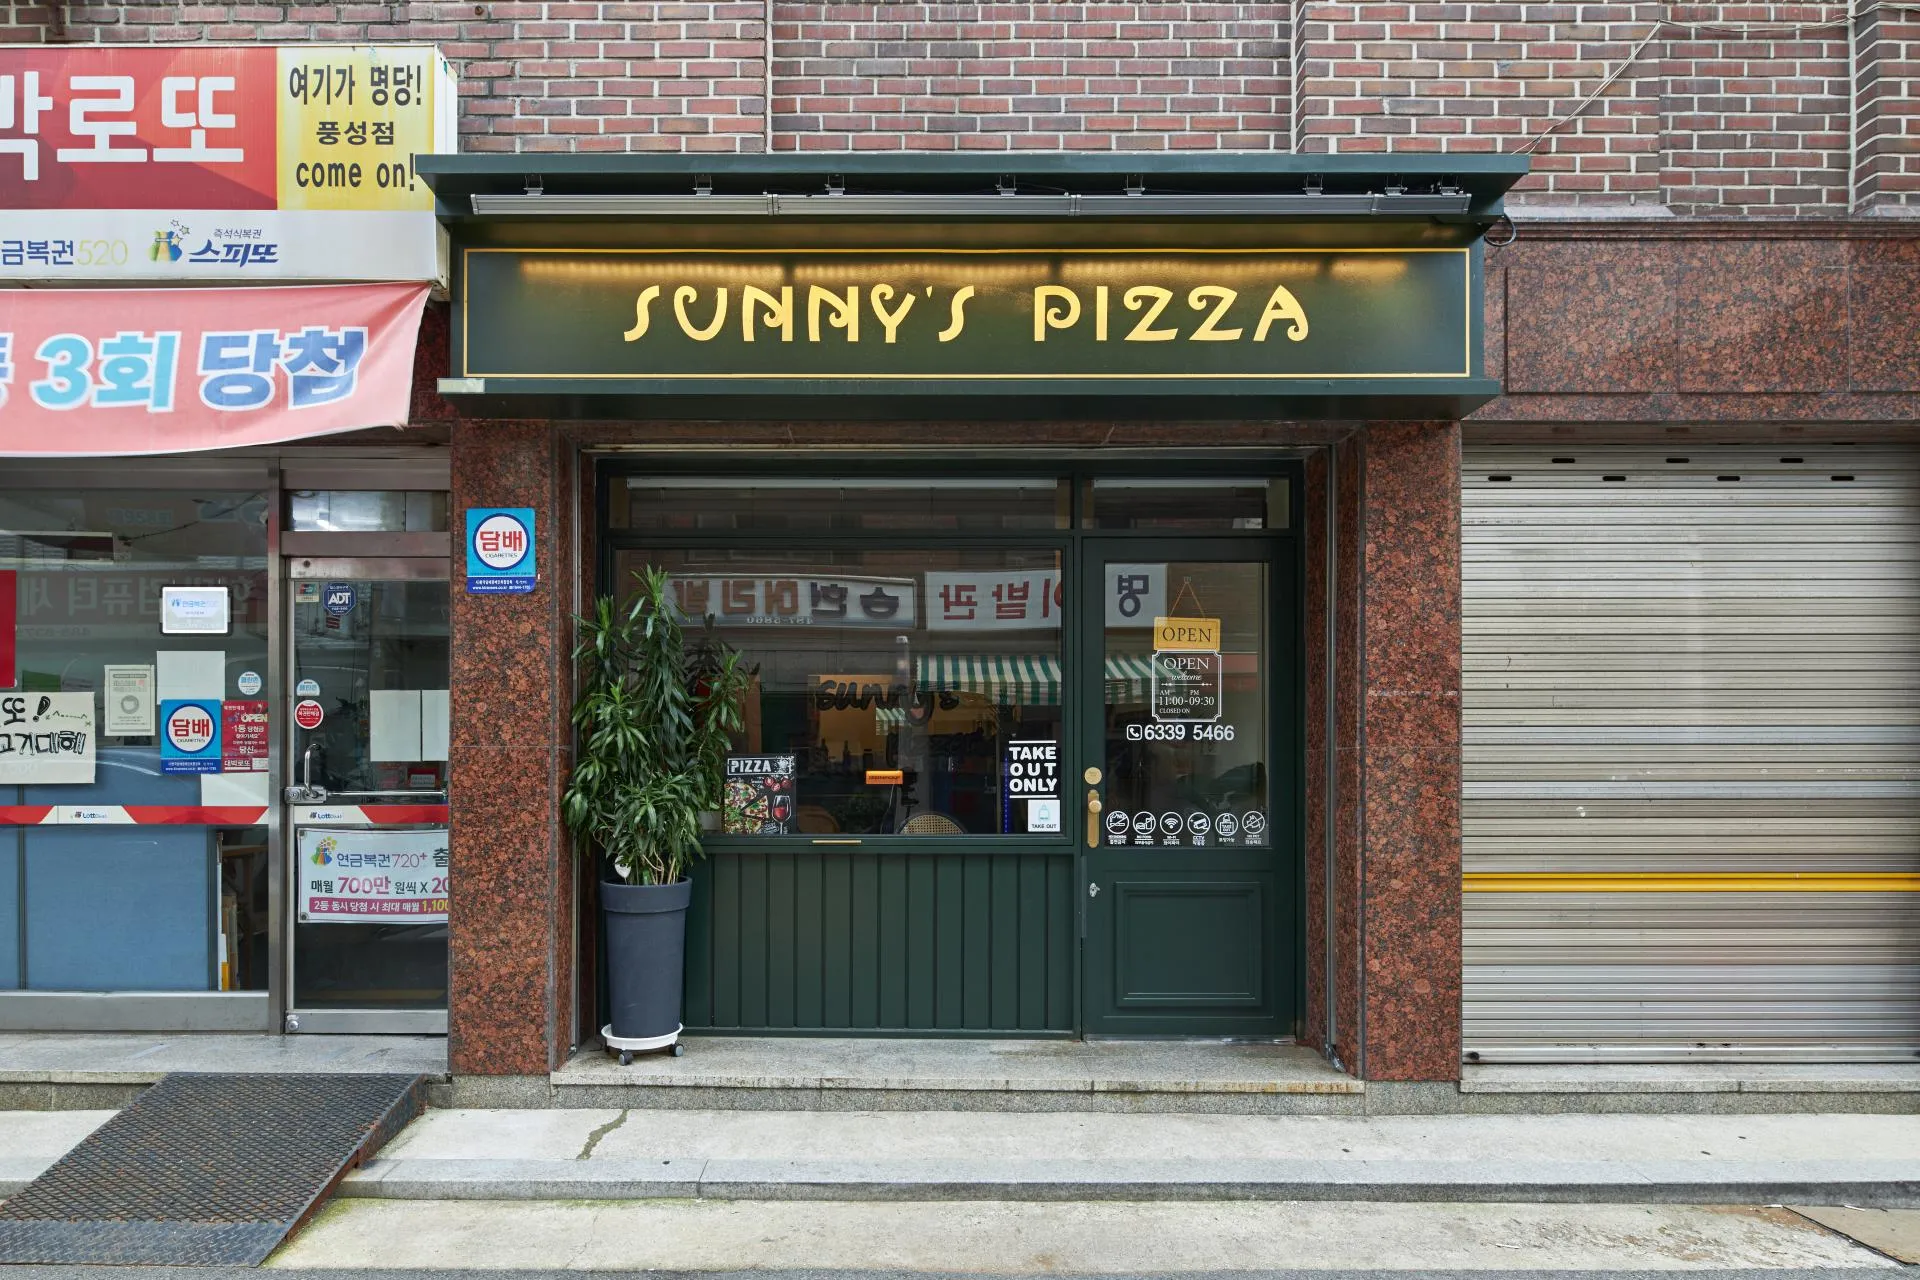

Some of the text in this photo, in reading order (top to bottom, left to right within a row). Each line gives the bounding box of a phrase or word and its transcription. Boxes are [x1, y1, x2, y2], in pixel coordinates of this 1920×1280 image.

[289, 64, 421, 106] 여기가 명당!
[316, 121, 394, 145] 풍성점
[296, 153, 414, 191] come on!
[214, 229, 262, 239] 즉석식복권
[189, 239, 278, 268] 스피또
[624, 284, 1309, 343] SUNNY'S PIZZA
[30, 331, 181, 412] 3회
[197, 326, 367, 412] 당첨
[479, 531, 523, 551] 담배
[328, 593, 350, 605] ADT
[1162, 627, 1211, 642] OPEN
[1163, 657, 1209, 670] OPEN
[1171, 670, 1202, 681] welcome
[241, 713, 268, 722] OPEN
[172, 718, 210, 737] 담배
[1144, 724, 1234, 741] 6339 5466
[1008, 746, 1057, 760] TAKE
[731, 759, 772, 773] PIZZA
[1009, 762, 1057, 777] OUT
[1009, 778, 1058, 792] ONLY
[311, 880, 334, 894] 매월
[338, 876, 391, 895] 700만
[394, 881, 417, 895] 원씩
[314, 901, 329, 911] 2등
[381, 902, 400, 912] 최대
[402, 902, 419, 913] 매월
